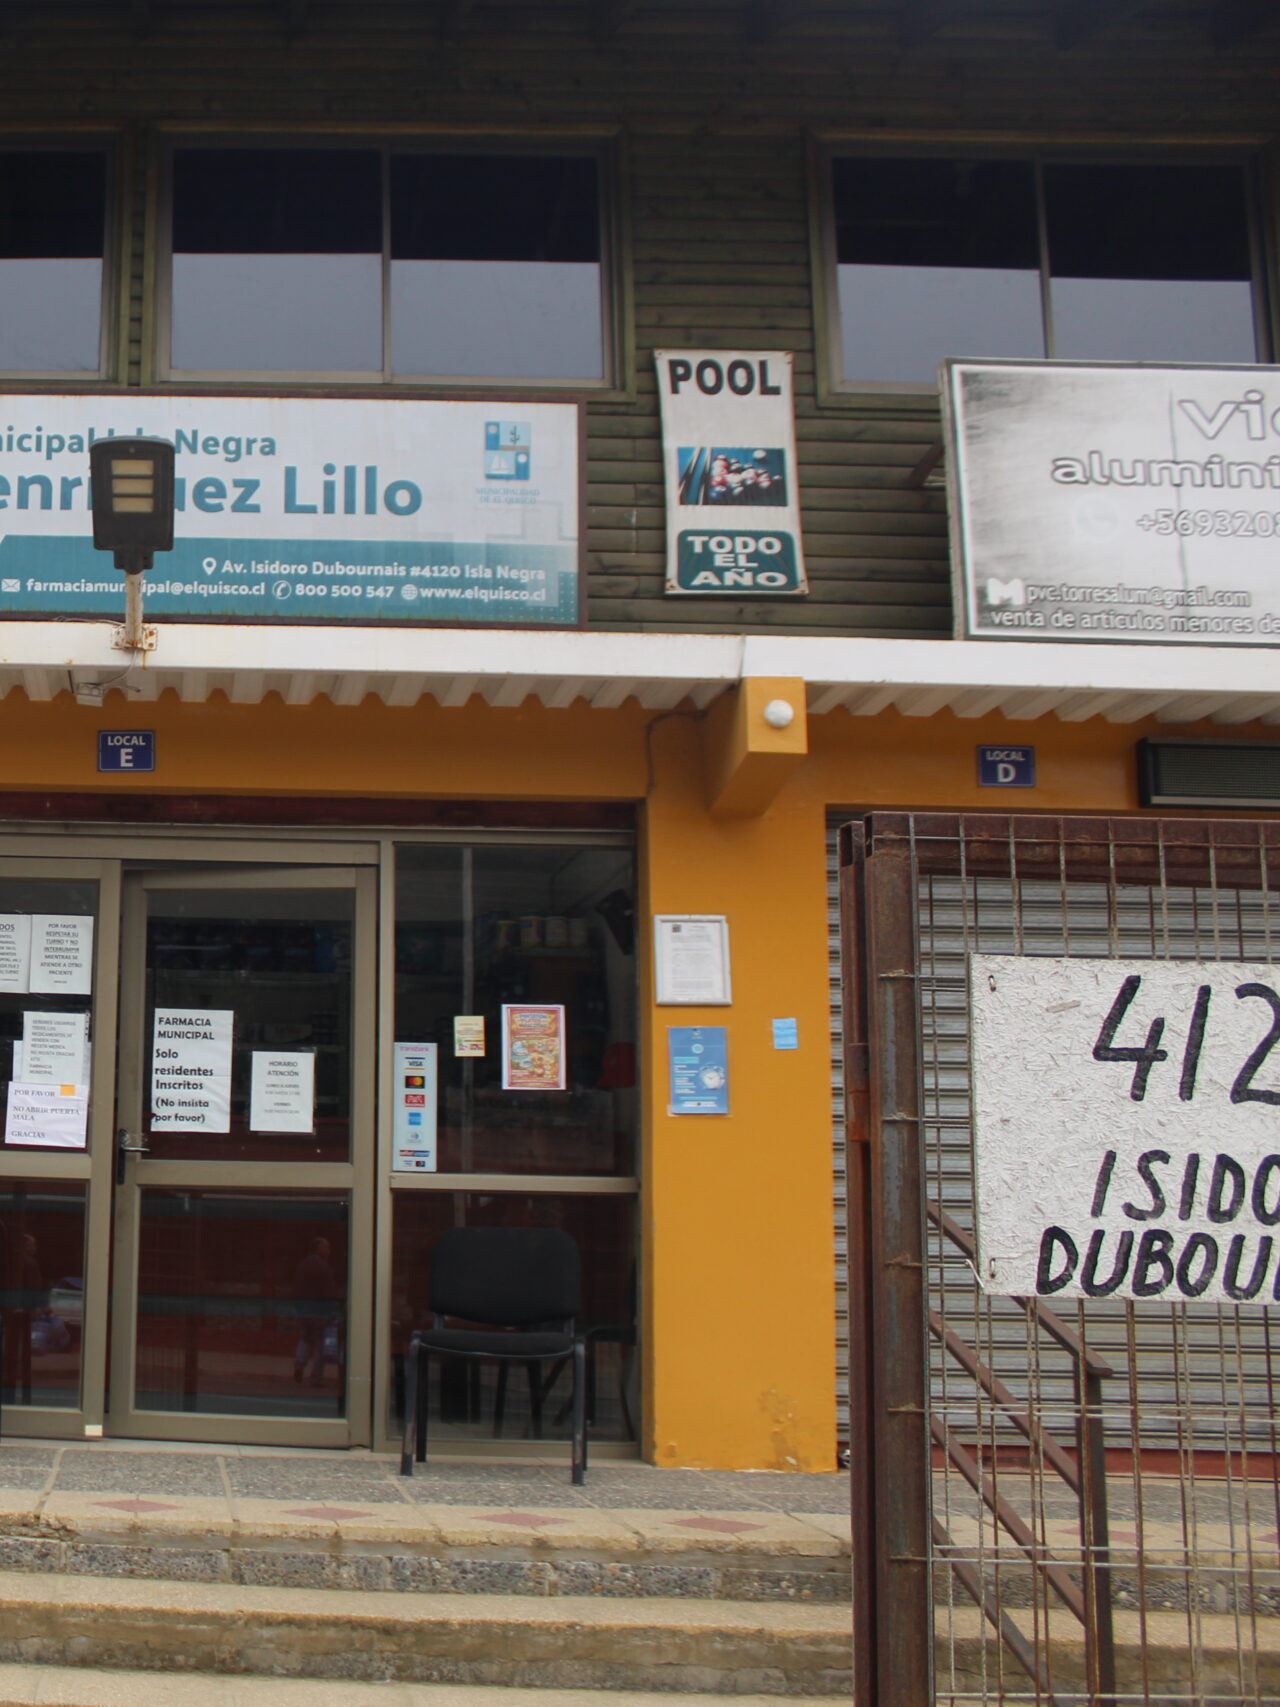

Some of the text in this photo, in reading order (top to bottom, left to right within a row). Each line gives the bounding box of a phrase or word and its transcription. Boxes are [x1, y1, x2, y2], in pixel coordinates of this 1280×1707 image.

[668, 358, 782, 396] POOL
[174, 429, 277, 463] Negra
[283, 463, 423, 516] Lillo
[1136, 508, 1280, 538] +569320
[687, 535, 782, 555] TODO
[713, 554, 758, 568] EL
[222, 560, 546, 582] Av. Isidoro Dubournais #4120 Isla Negra
[690, 568, 788, 587] AÑO
[294, 584, 328, 598] 800
[331, 584, 363, 598] 500
[366, 585, 395, 599] 547
[420, 585, 547, 604] www.elquisco.cl
[991, 609, 1045, 628] venta
[1051, 608, 1076, 629] de
[1170, 614, 1255, 634] menores
[107, 736, 146, 746] LOCAL
[120, 748, 134, 767] E
[986, 751, 1026, 762] LOCAL
[998, 764, 1016, 783] D
[158, 1016, 212, 1026] FARMACIA
[158, 1030, 215, 1040] MUNICIPAL
[155, 1048, 179, 1059] Solo
[154, 1066, 214, 1077] residentes
[156, 1080, 204, 1090] Inscritos
[31, 1089, 56, 1097] FAVOR
[155, 1098, 210, 1108] (No insista
[12, 1114, 35, 1122] MALA
[155, 1113, 206, 1124] por favor)
[11, 1130, 46, 1138] GRACIAS
[1035, 1225, 1280, 1301] DUBOU
